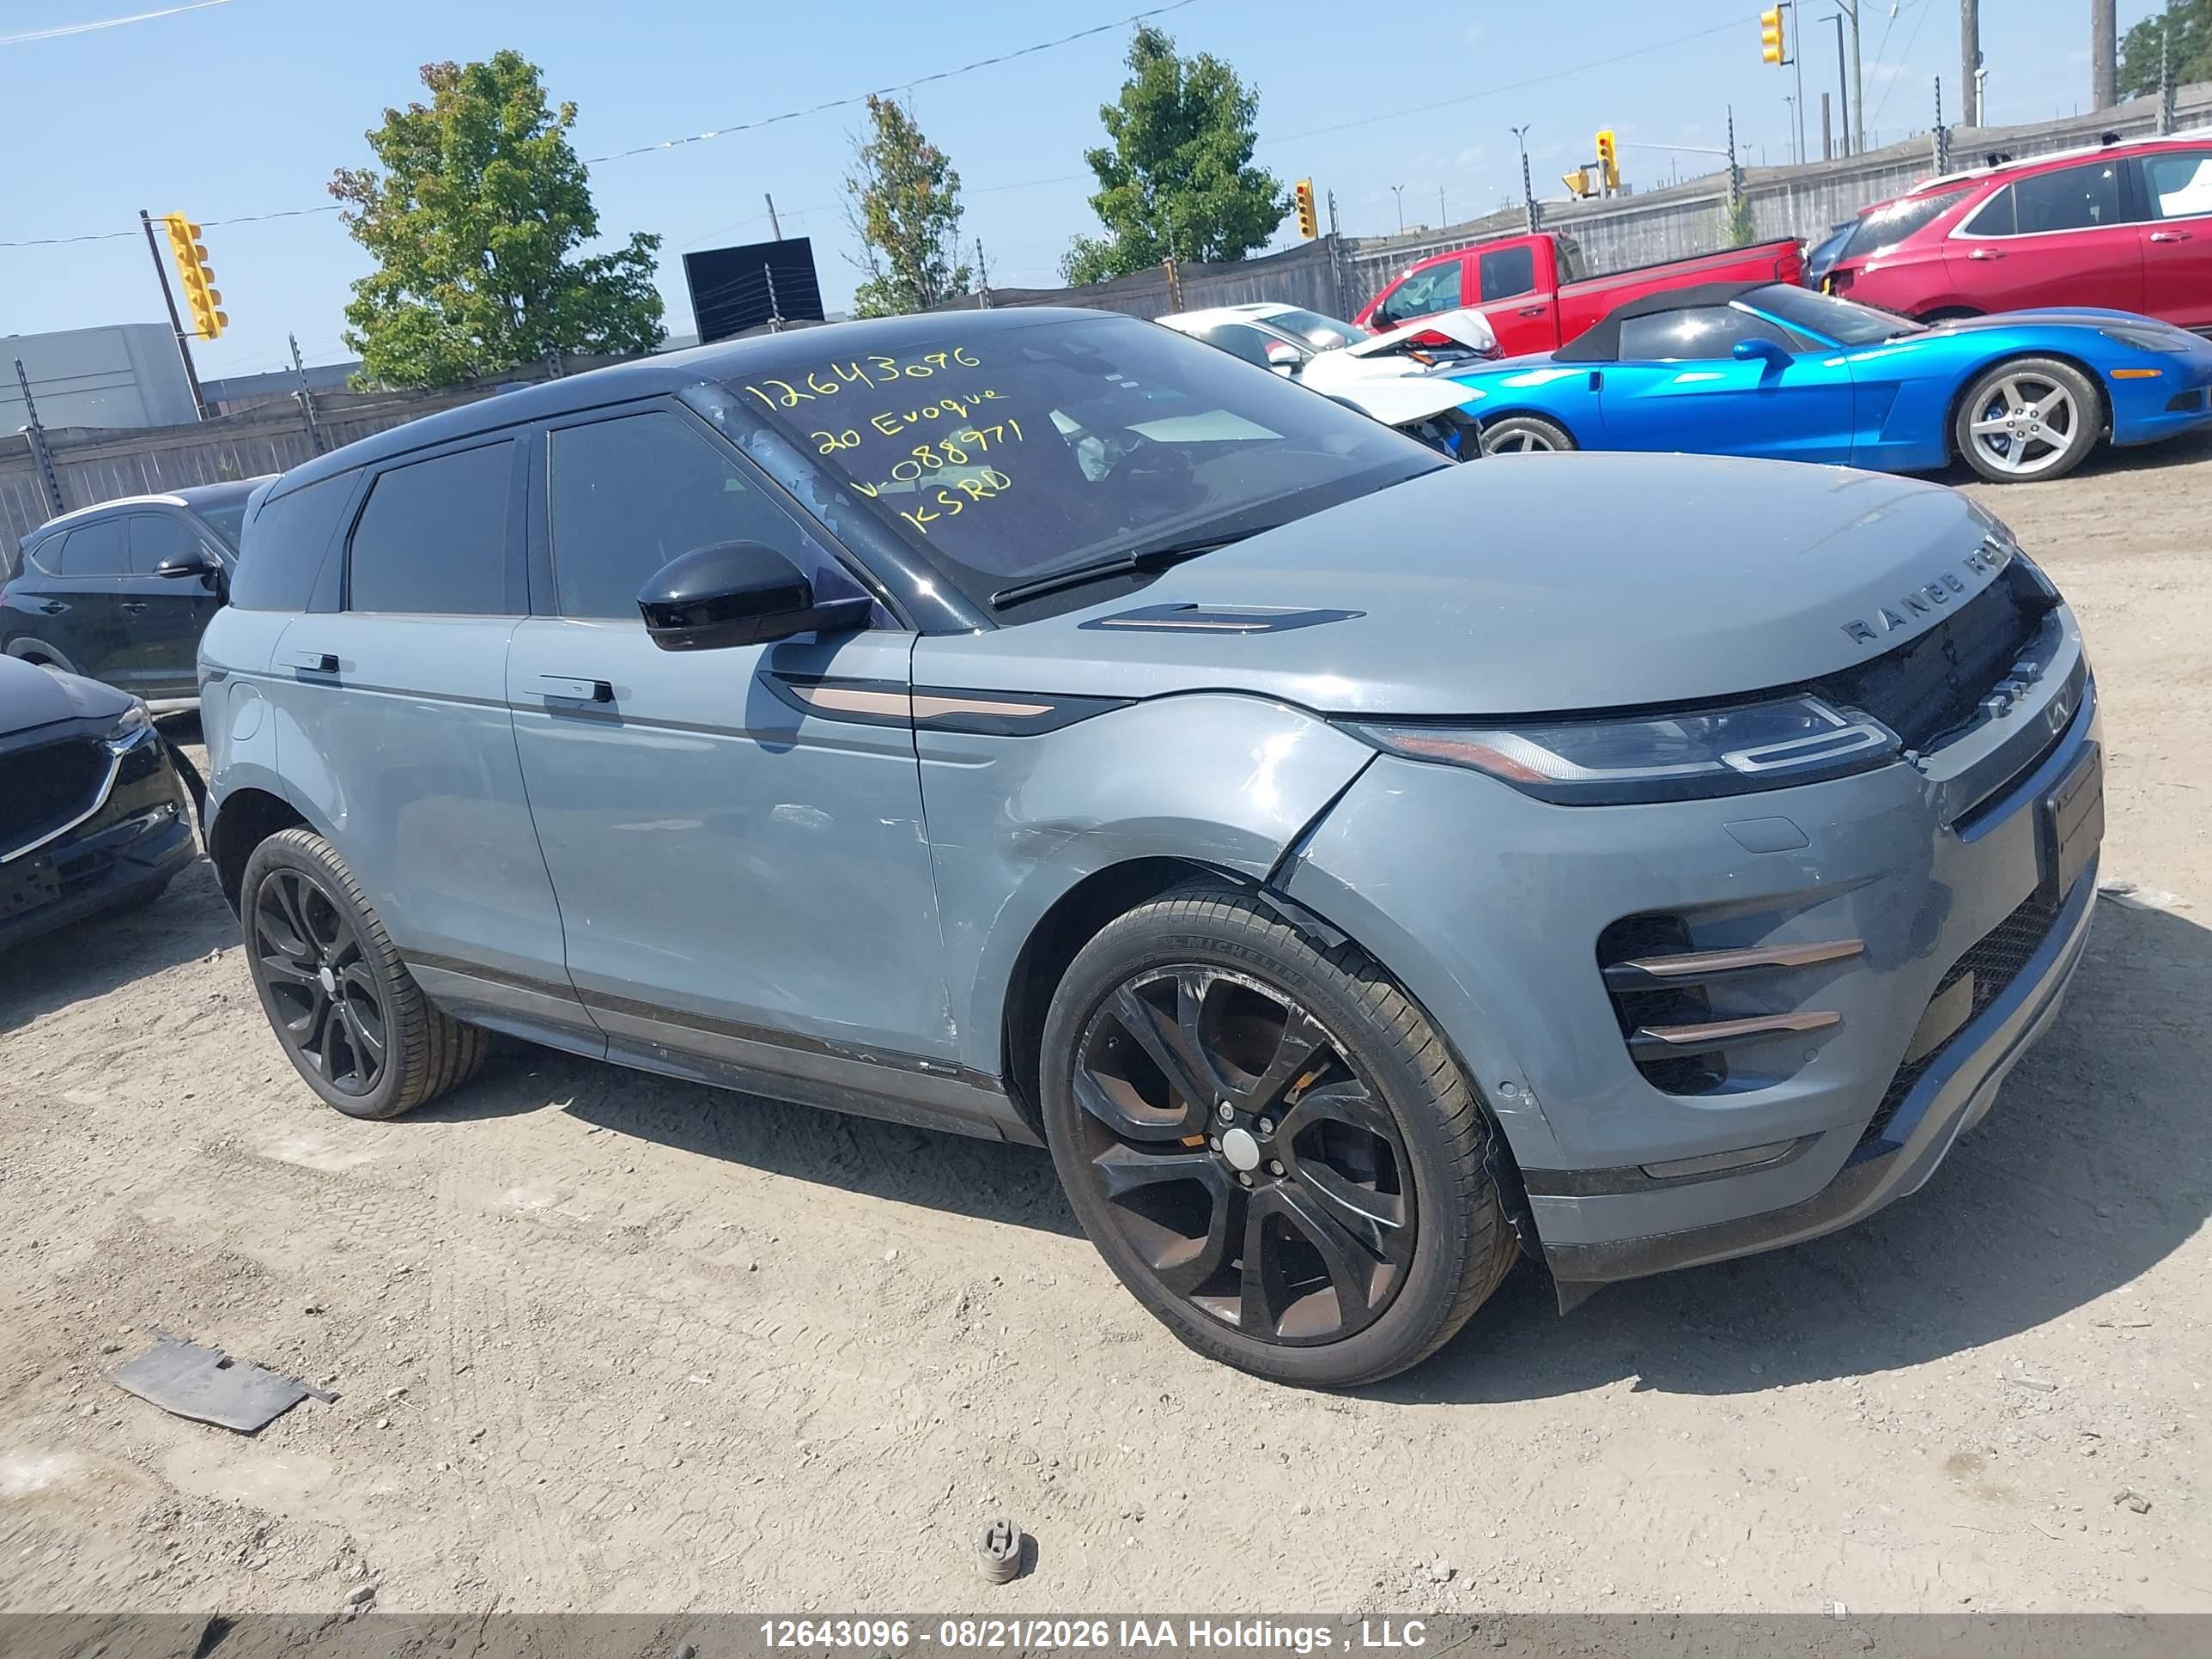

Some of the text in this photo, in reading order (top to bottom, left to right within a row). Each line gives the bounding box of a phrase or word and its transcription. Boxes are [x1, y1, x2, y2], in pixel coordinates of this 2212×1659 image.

[745, 347, 981, 412] 12643096
[811, 389, 1011, 455] 20 Evoque
[1840, 572, 1966, 645] RANGE
[1186, 936, 1303, 987] MICHELIN
